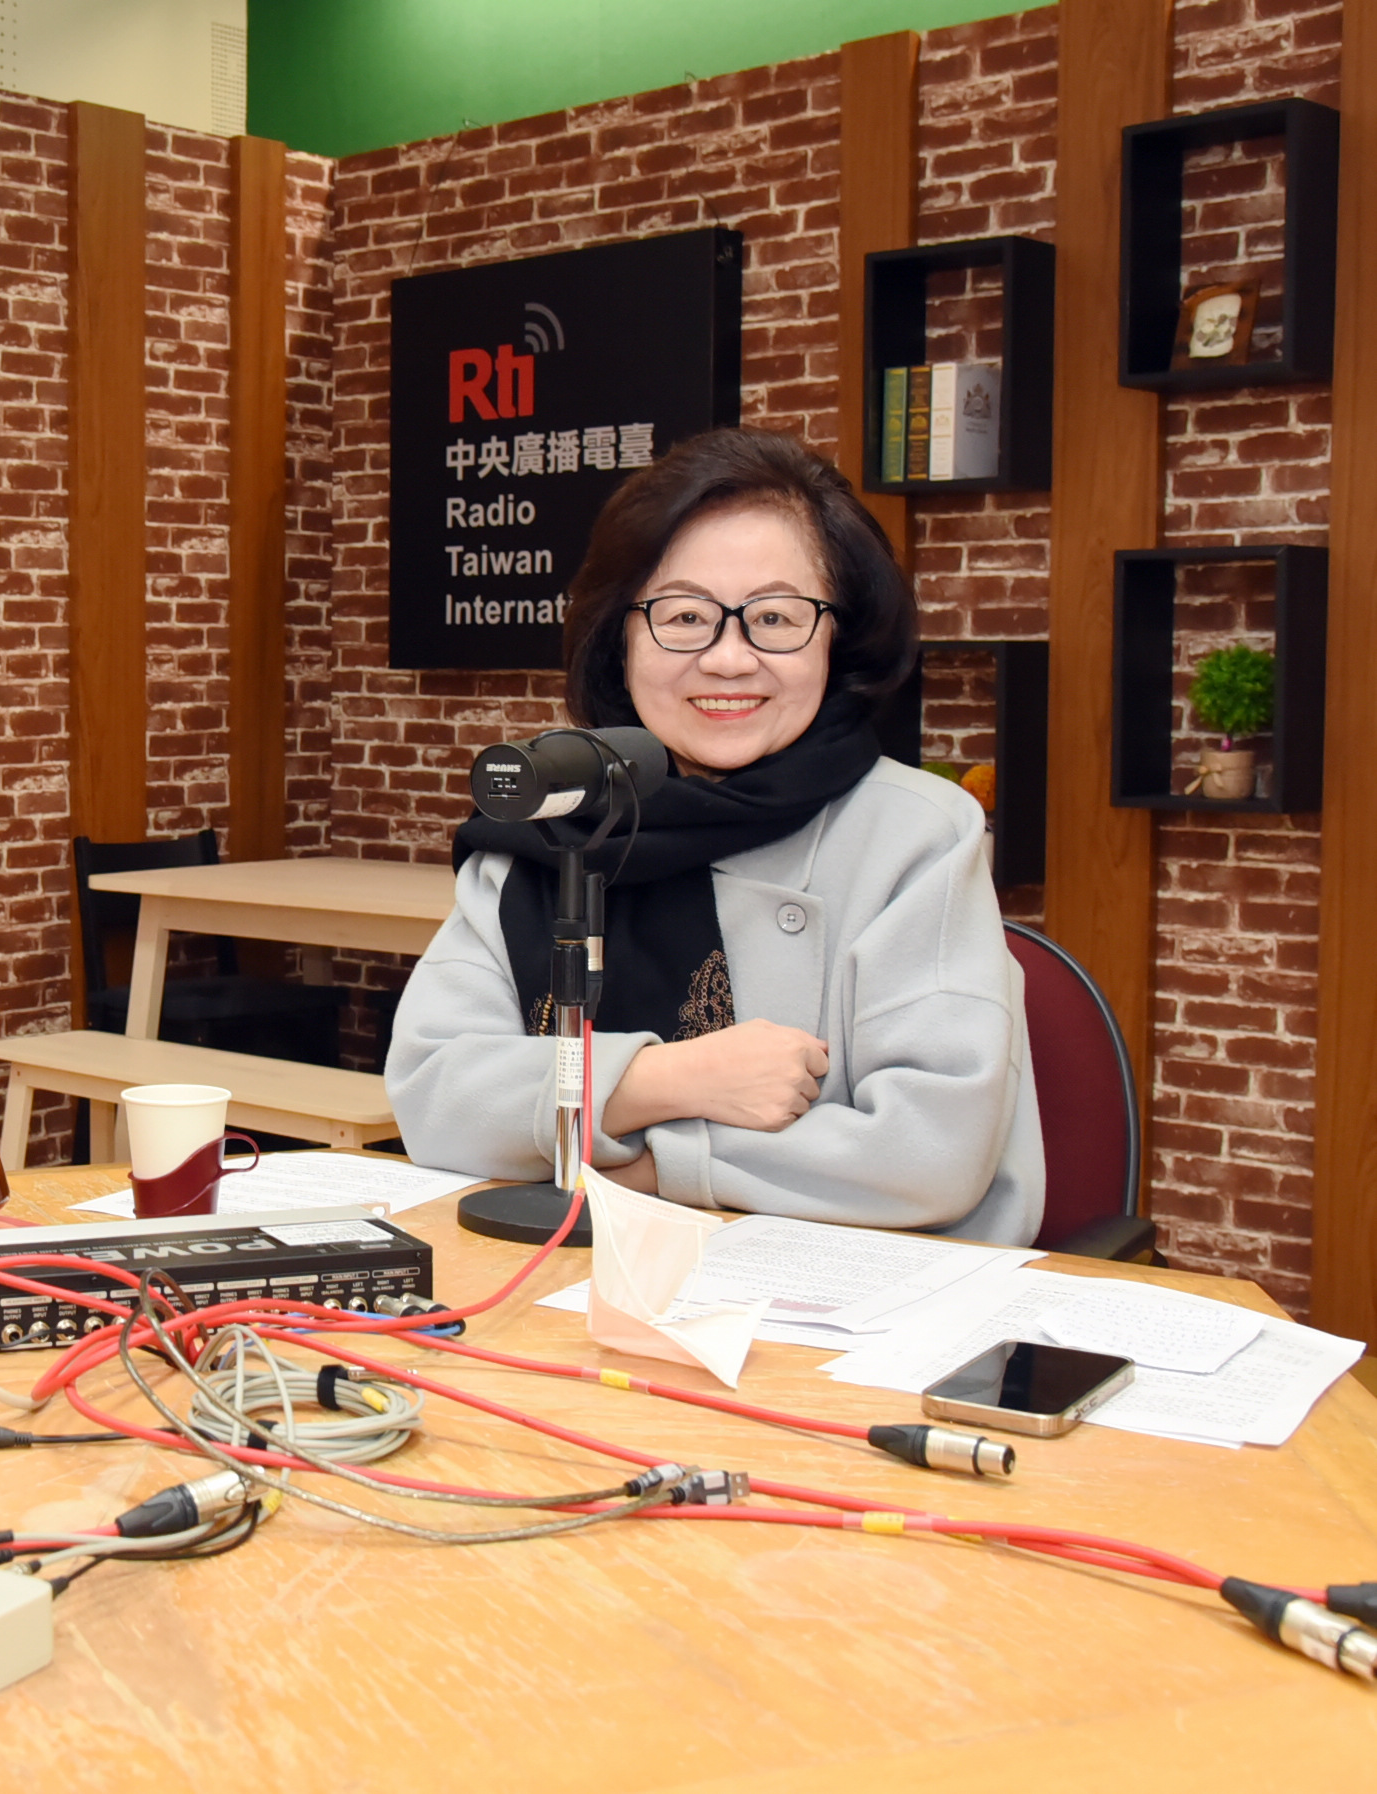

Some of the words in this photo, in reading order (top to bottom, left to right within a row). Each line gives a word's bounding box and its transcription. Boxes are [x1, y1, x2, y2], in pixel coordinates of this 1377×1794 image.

[448, 343, 535, 423] Rti
[445, 422, 655, 481] 中央廣播電臺
[446, 493, 536, 529] Radio
[445, 544, 553, 577] Taiwan
[445, 593, 573, 625] Internat
[485, 763, 522, 773] SHURE
